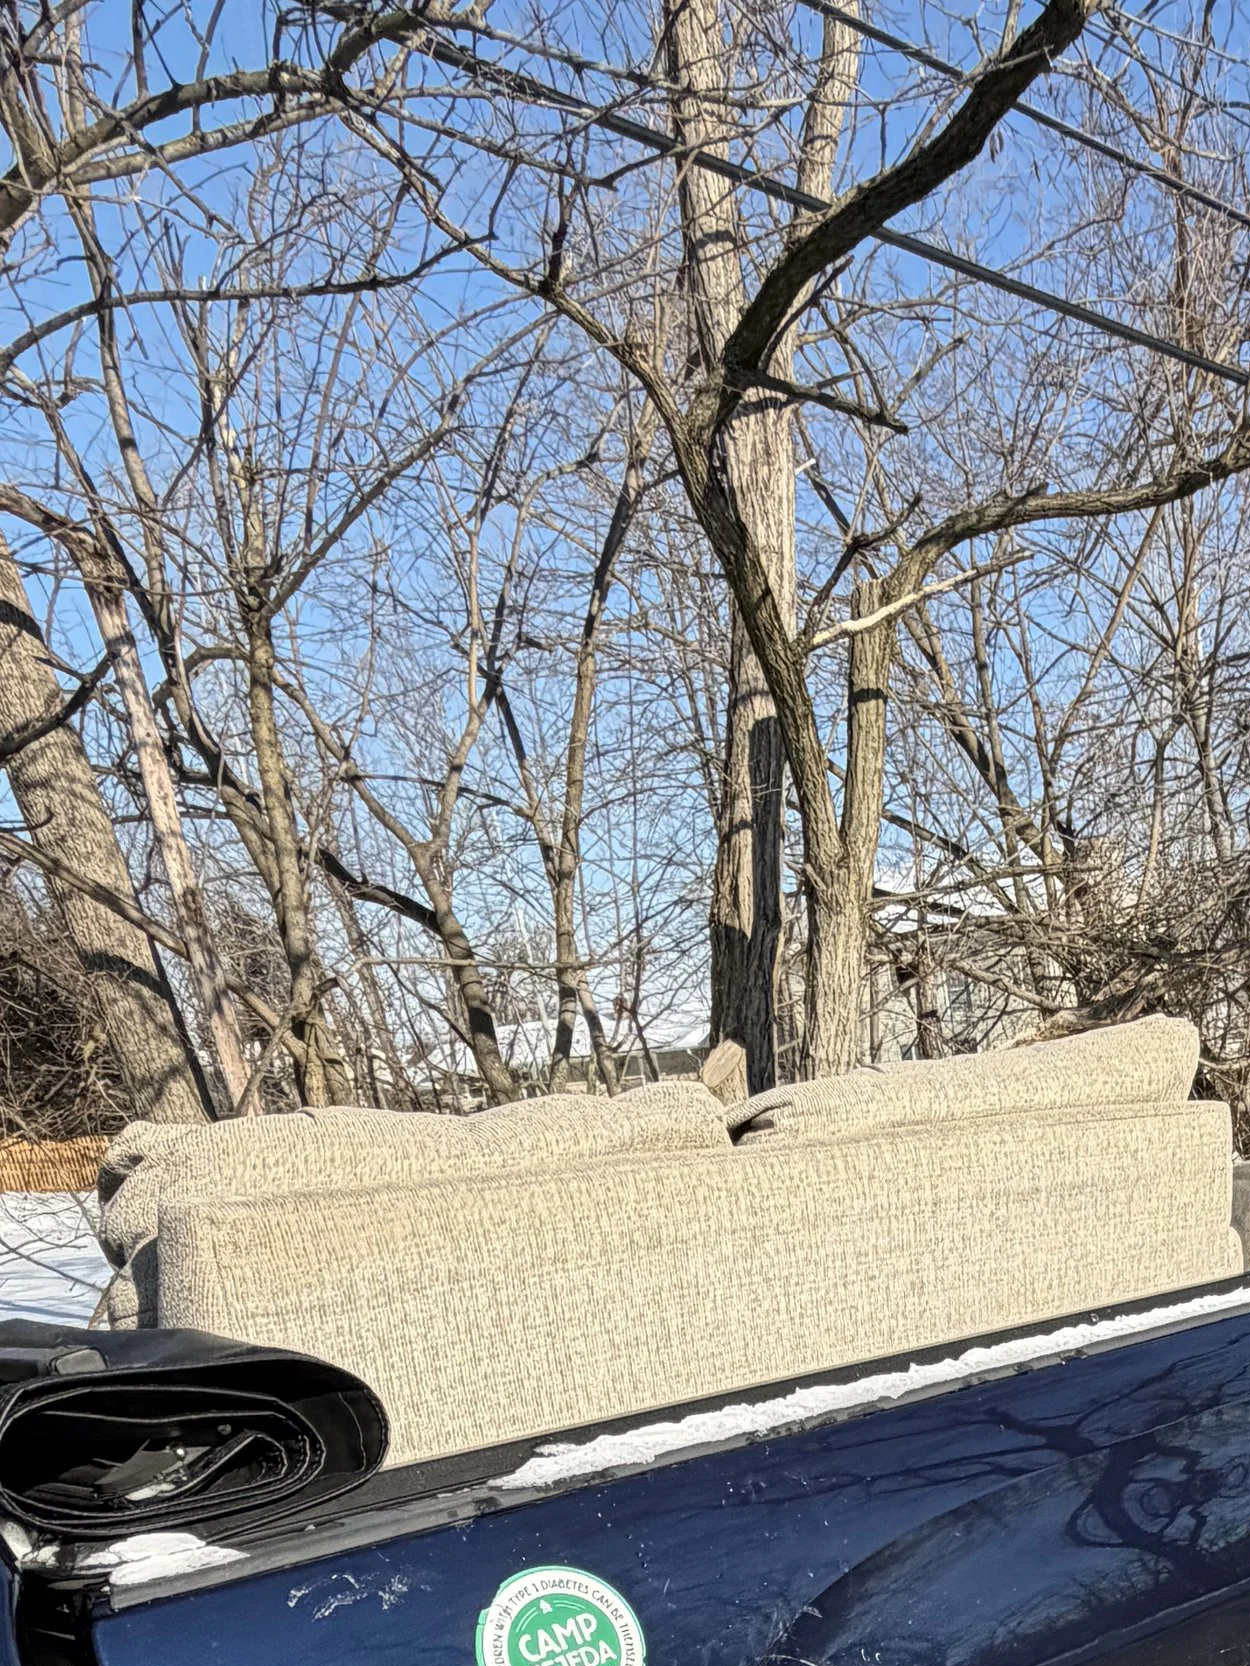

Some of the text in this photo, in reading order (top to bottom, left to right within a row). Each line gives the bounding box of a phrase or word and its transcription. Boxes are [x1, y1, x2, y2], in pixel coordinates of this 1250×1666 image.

[508, 1587, 533, 1608] TYPE
[533, 1582, 540, 1592] 1
[542, 1579, 589, 1594] DIABETES
[592, 1590, 613, 1609] CAN
[611, 1608, 624, 1621] BE
[518, 1612, 598, 1662] CAMP
